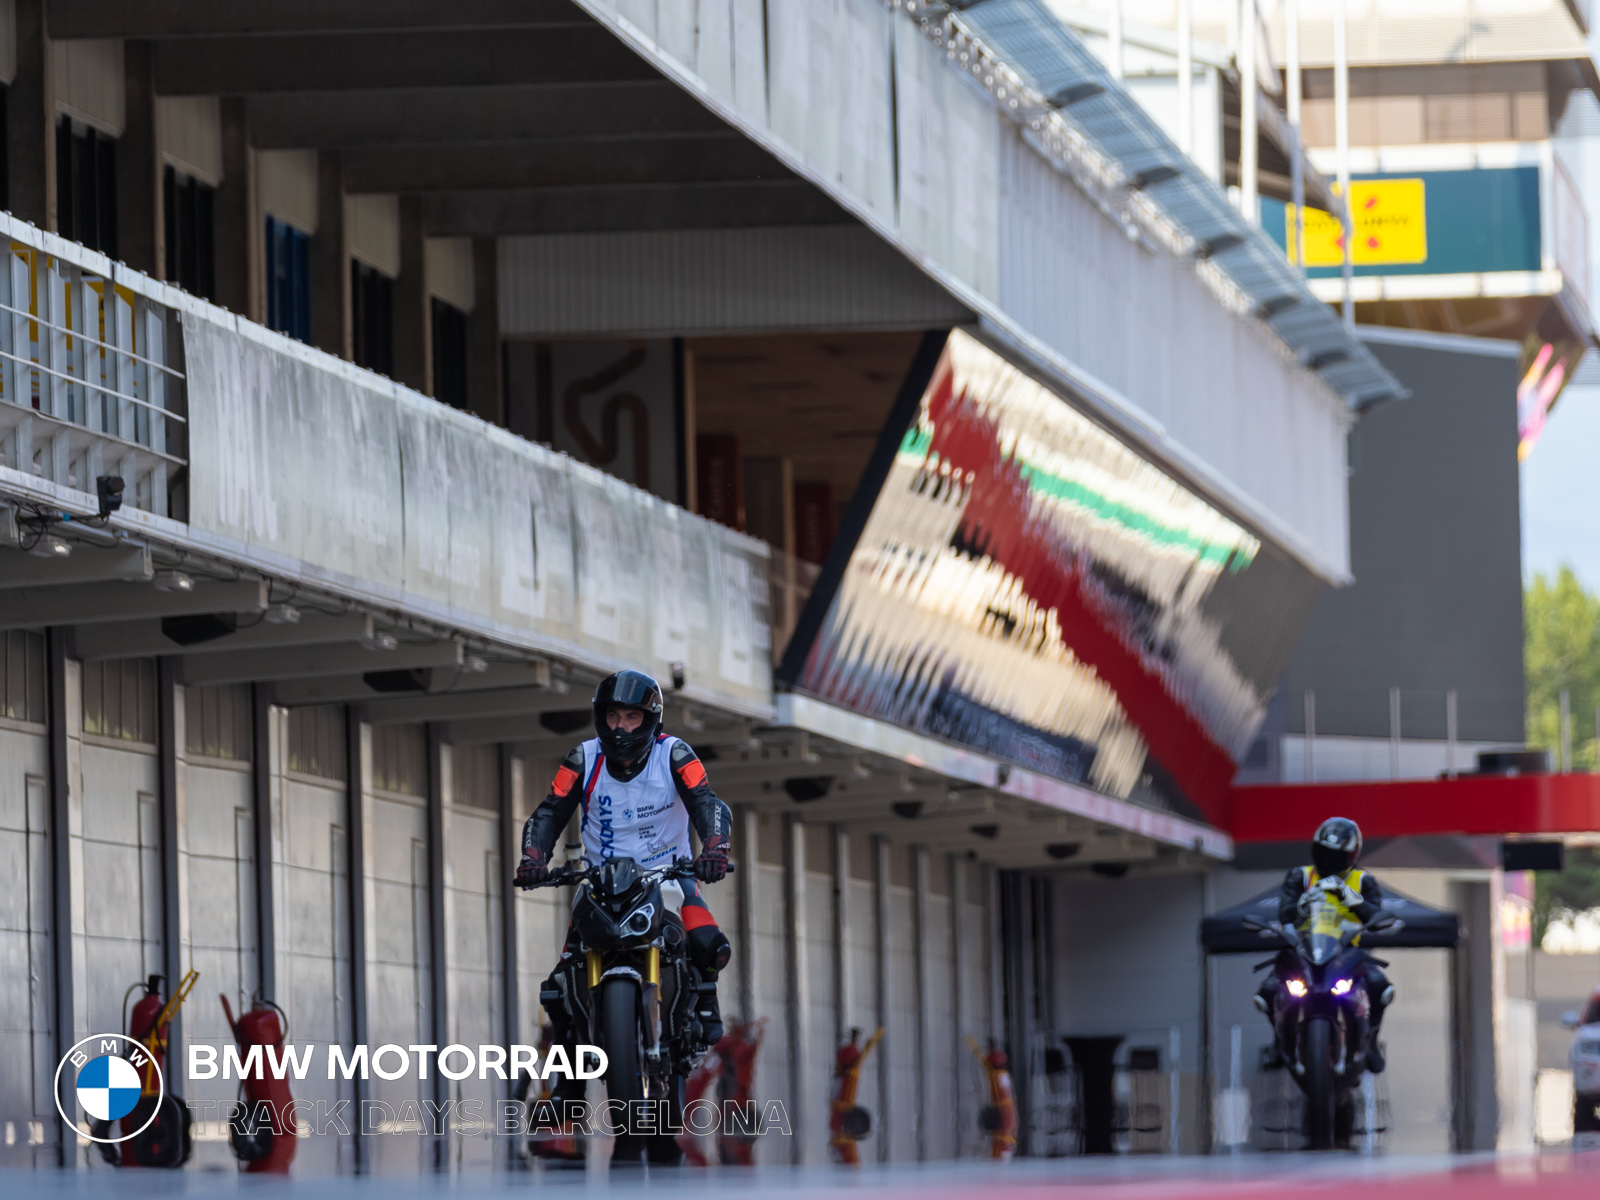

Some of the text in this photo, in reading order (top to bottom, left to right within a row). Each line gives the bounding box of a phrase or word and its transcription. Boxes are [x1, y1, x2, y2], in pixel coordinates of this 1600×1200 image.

[636, 804, 655, 813] BMW
[637, 802, 675, 819] MOTORRAD
[598, 794, 615, 867] CKDAYS
[640, 845, 678, 863] MICHELIN
